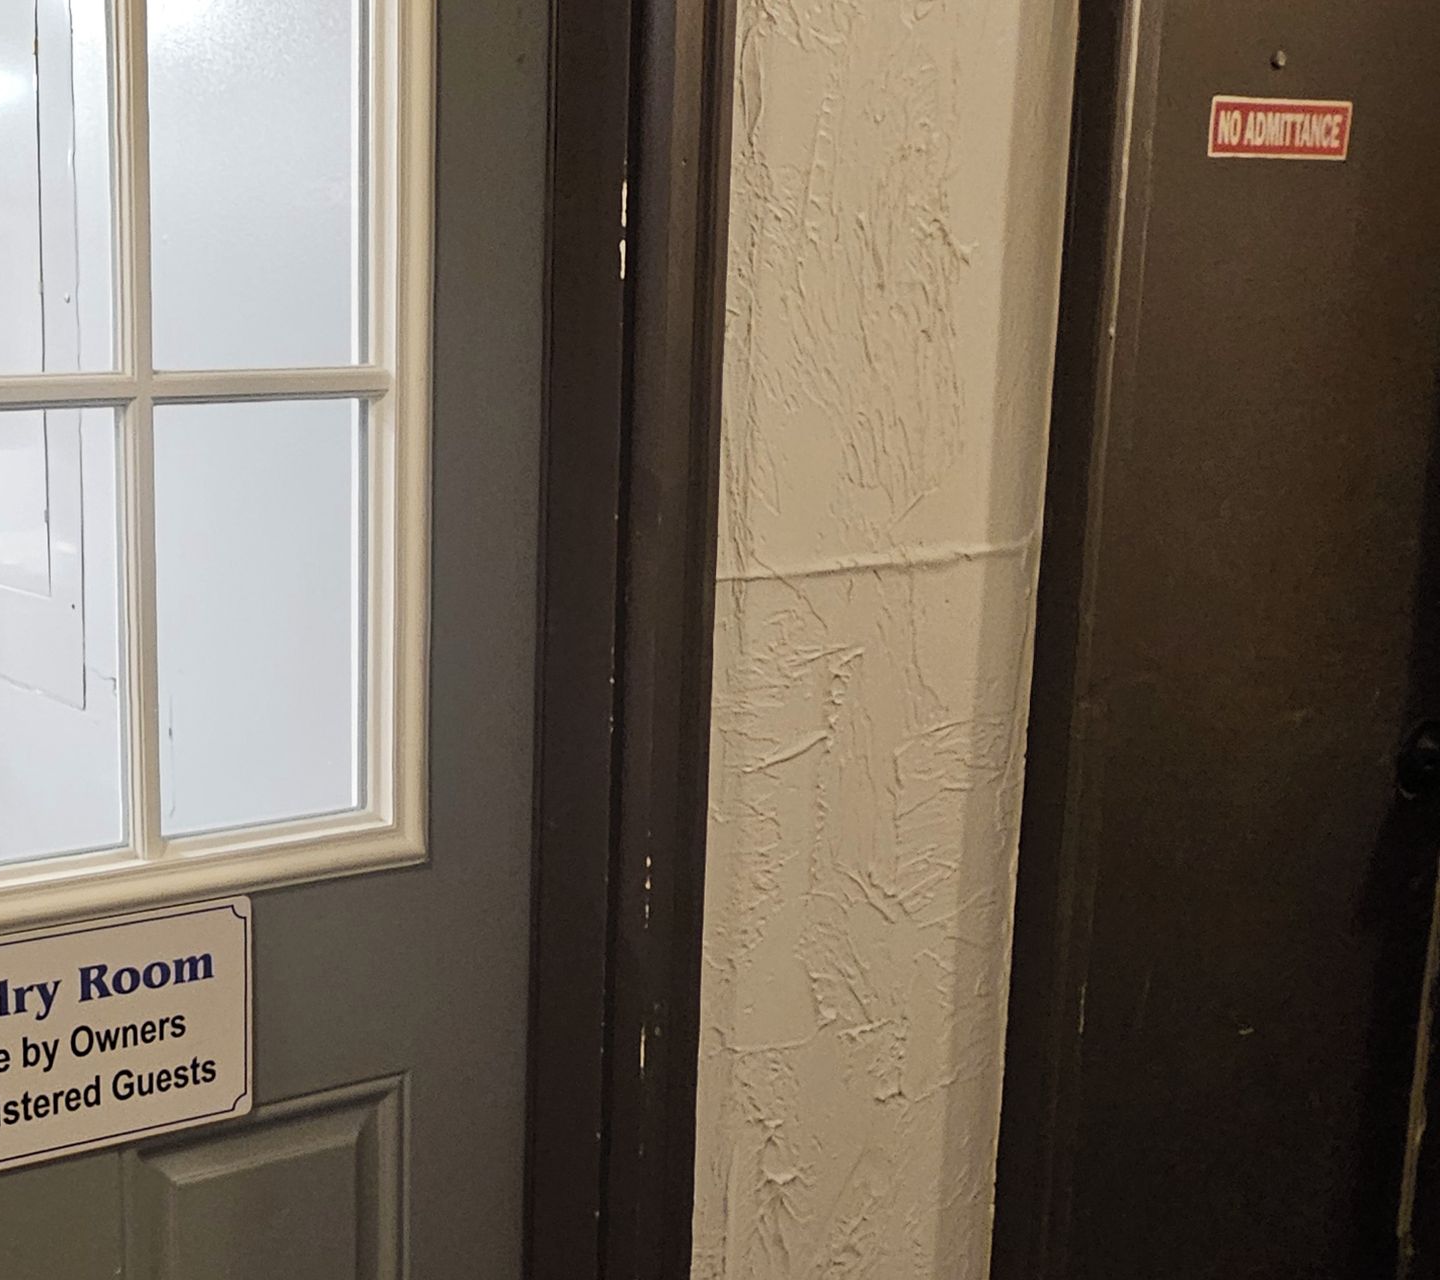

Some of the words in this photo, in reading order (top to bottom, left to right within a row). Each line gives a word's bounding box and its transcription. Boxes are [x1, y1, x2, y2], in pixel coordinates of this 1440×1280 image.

[1217, 110, 1242, 145] NO
[1243, 111, 1343, 148] ADMITTANCE
[78, 952, 215, 1003] Room
[22, 1036, 60, 1072] by
[70, 1014, 187, 1058] Owners
[112, 1056, 217, 1101] Guests
